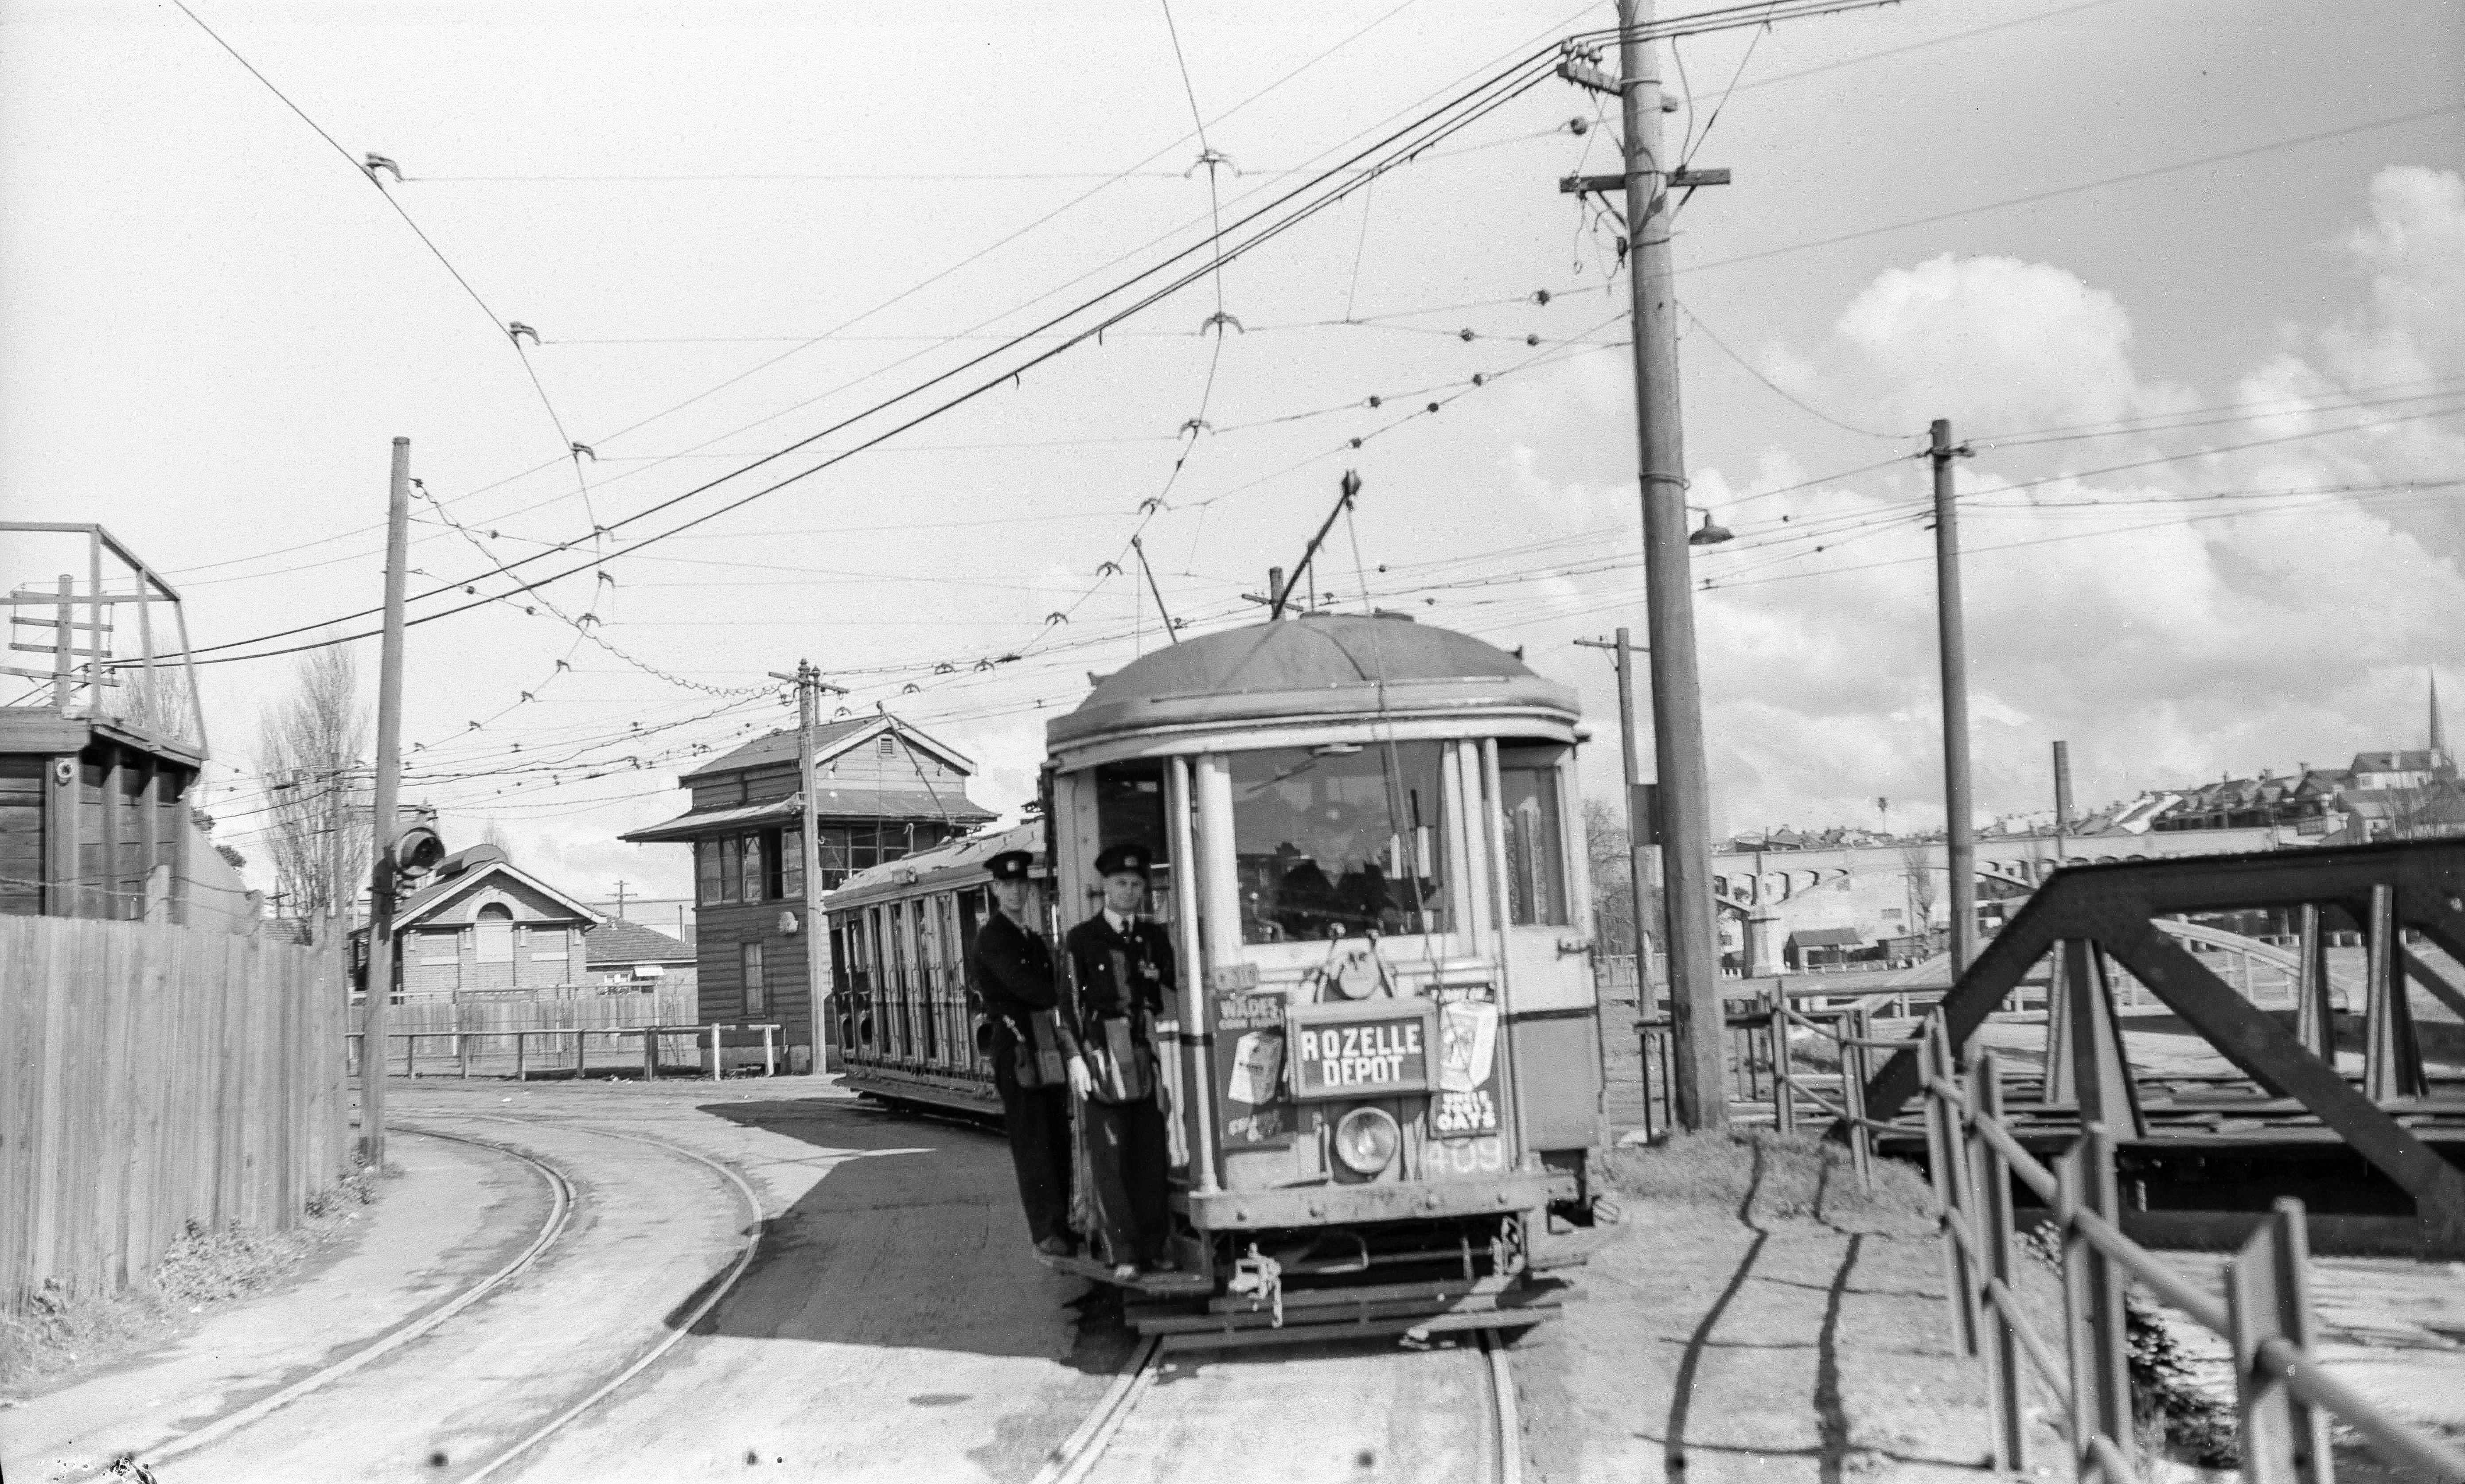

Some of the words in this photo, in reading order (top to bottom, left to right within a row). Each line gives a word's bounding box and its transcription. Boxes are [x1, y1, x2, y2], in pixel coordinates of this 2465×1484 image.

[1300, 1024, 1422, 1060] ROZELLE
[1322, 1055, 1404, 1086] DEPOT
[1437, 1112, 1496, 1131] OATS
